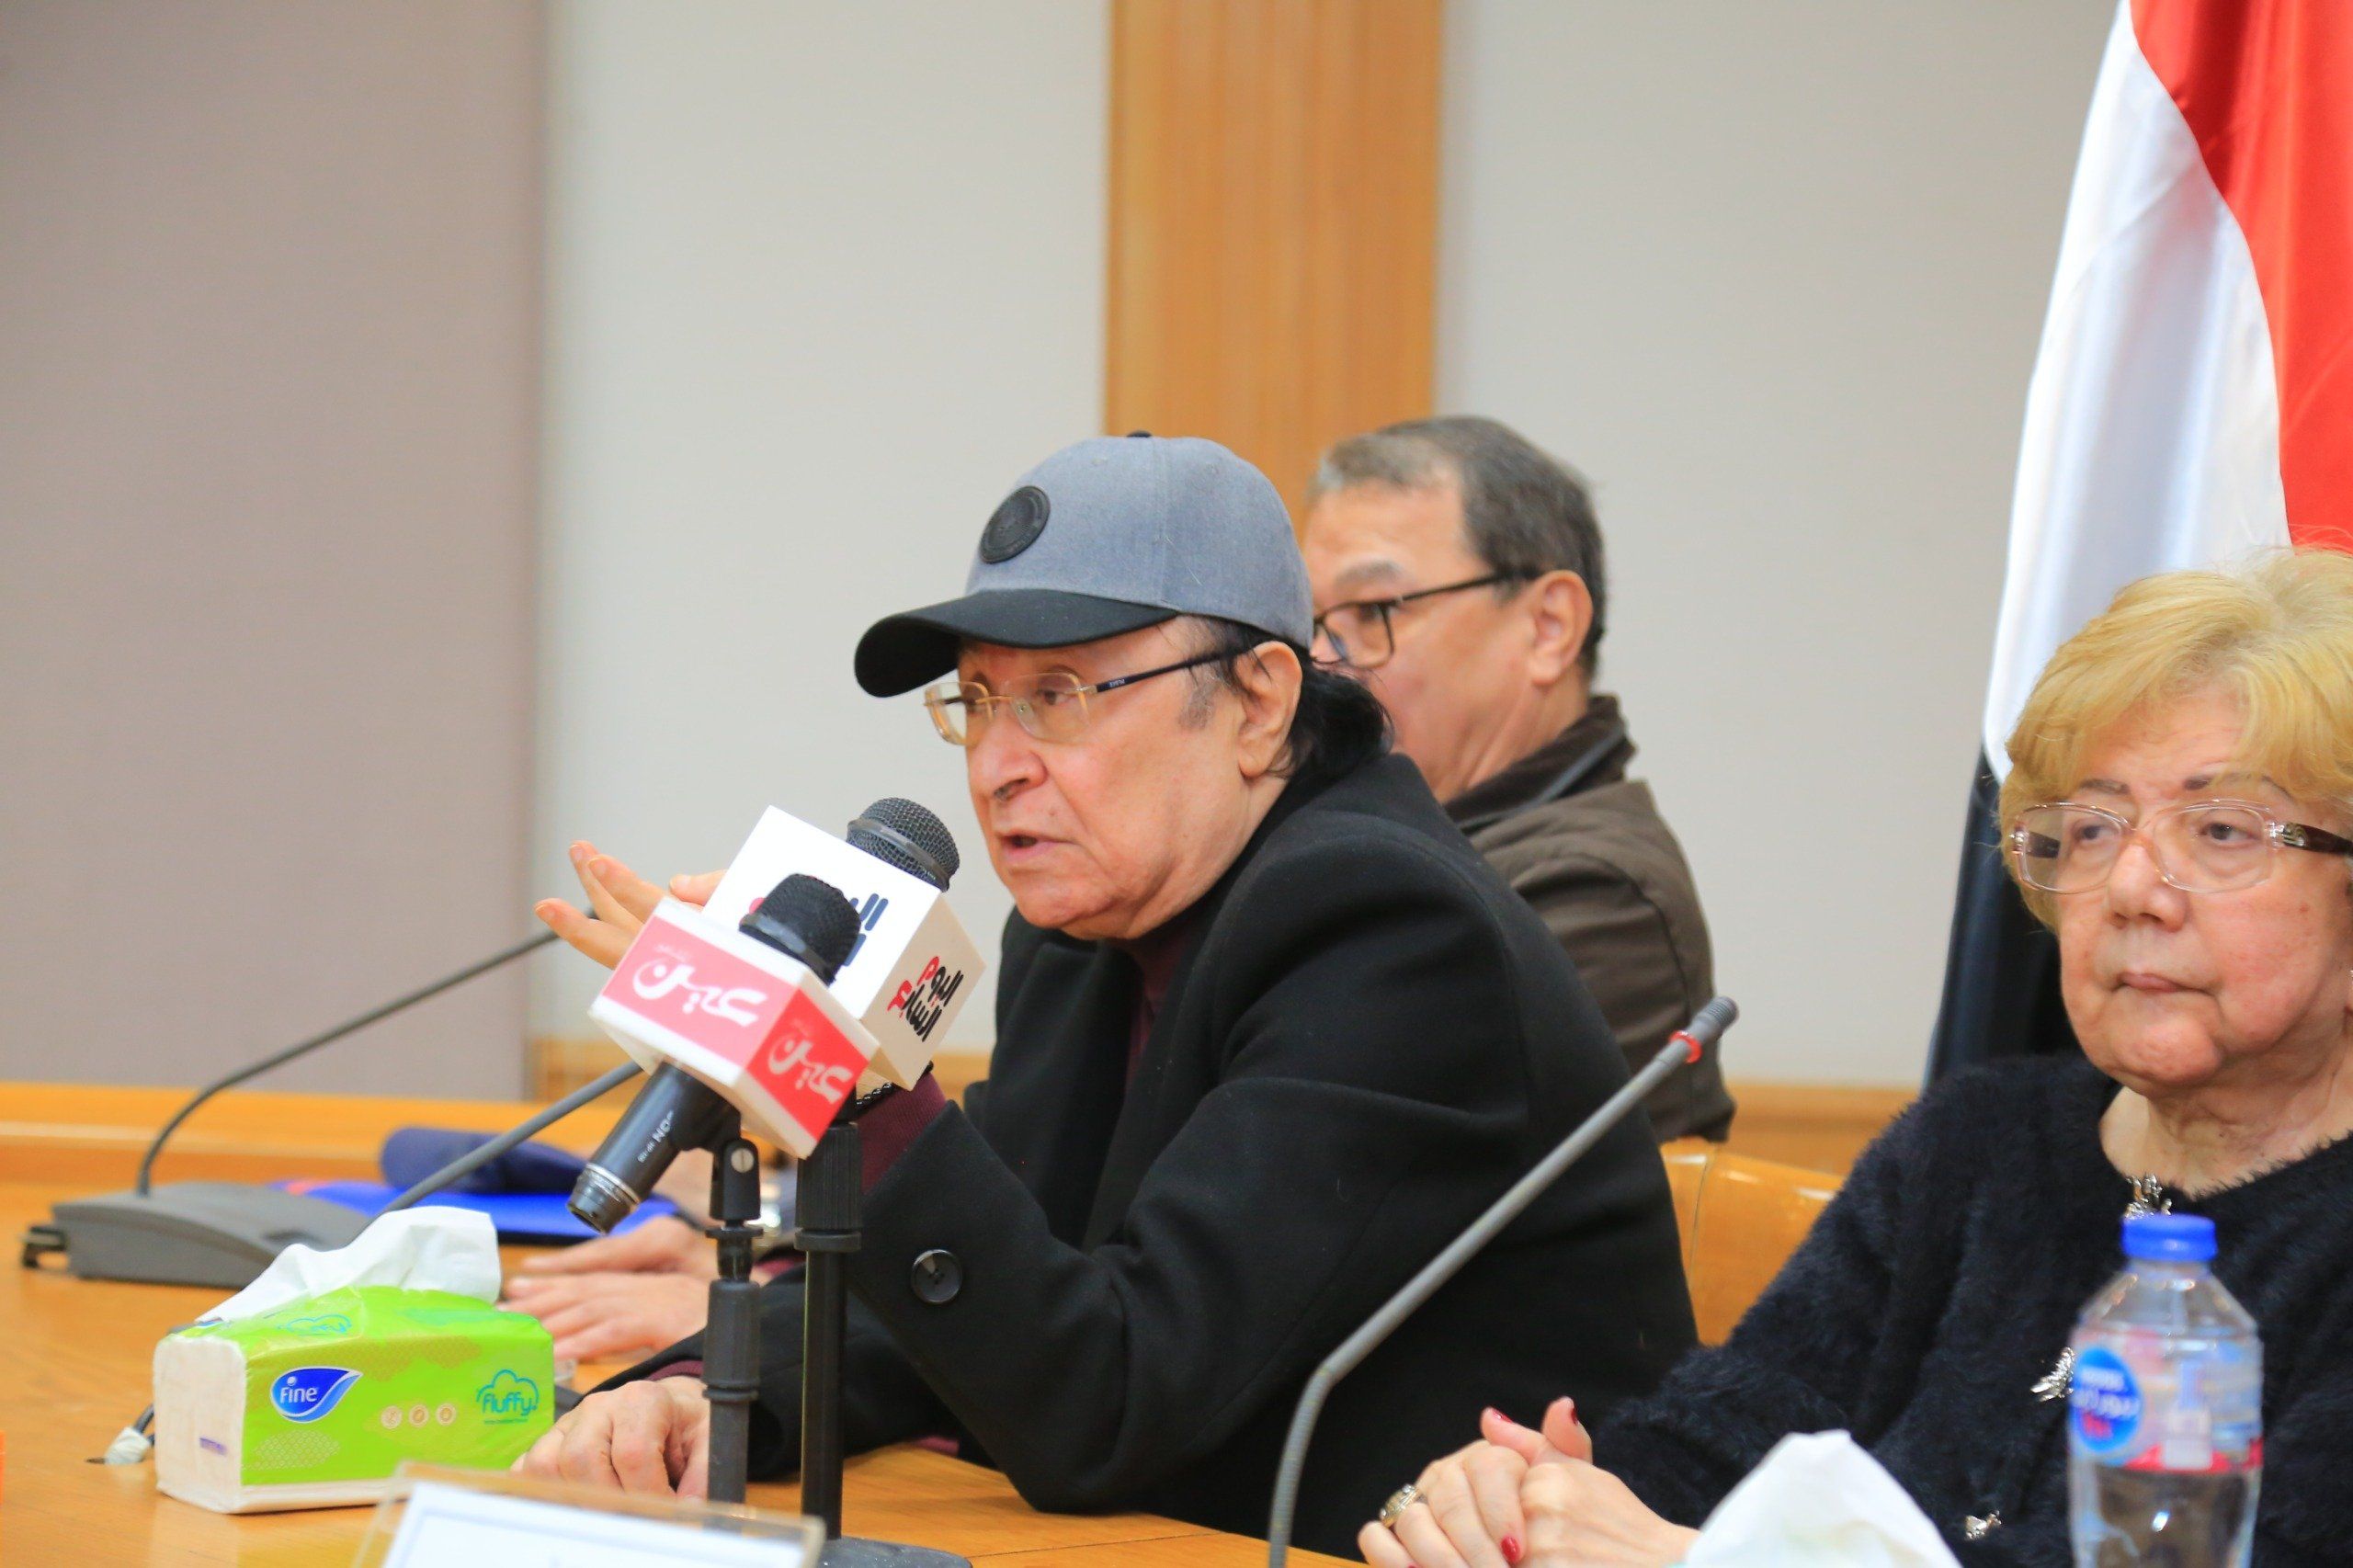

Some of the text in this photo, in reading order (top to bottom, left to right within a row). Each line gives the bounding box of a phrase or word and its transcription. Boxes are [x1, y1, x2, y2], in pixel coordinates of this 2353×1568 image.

[632, 957, 768, 1028] عين
[886, 980, 943, 1042] السابع
[916, 956, 964, 1007] اليوم
[767, 1033, 853, 1105] عين
